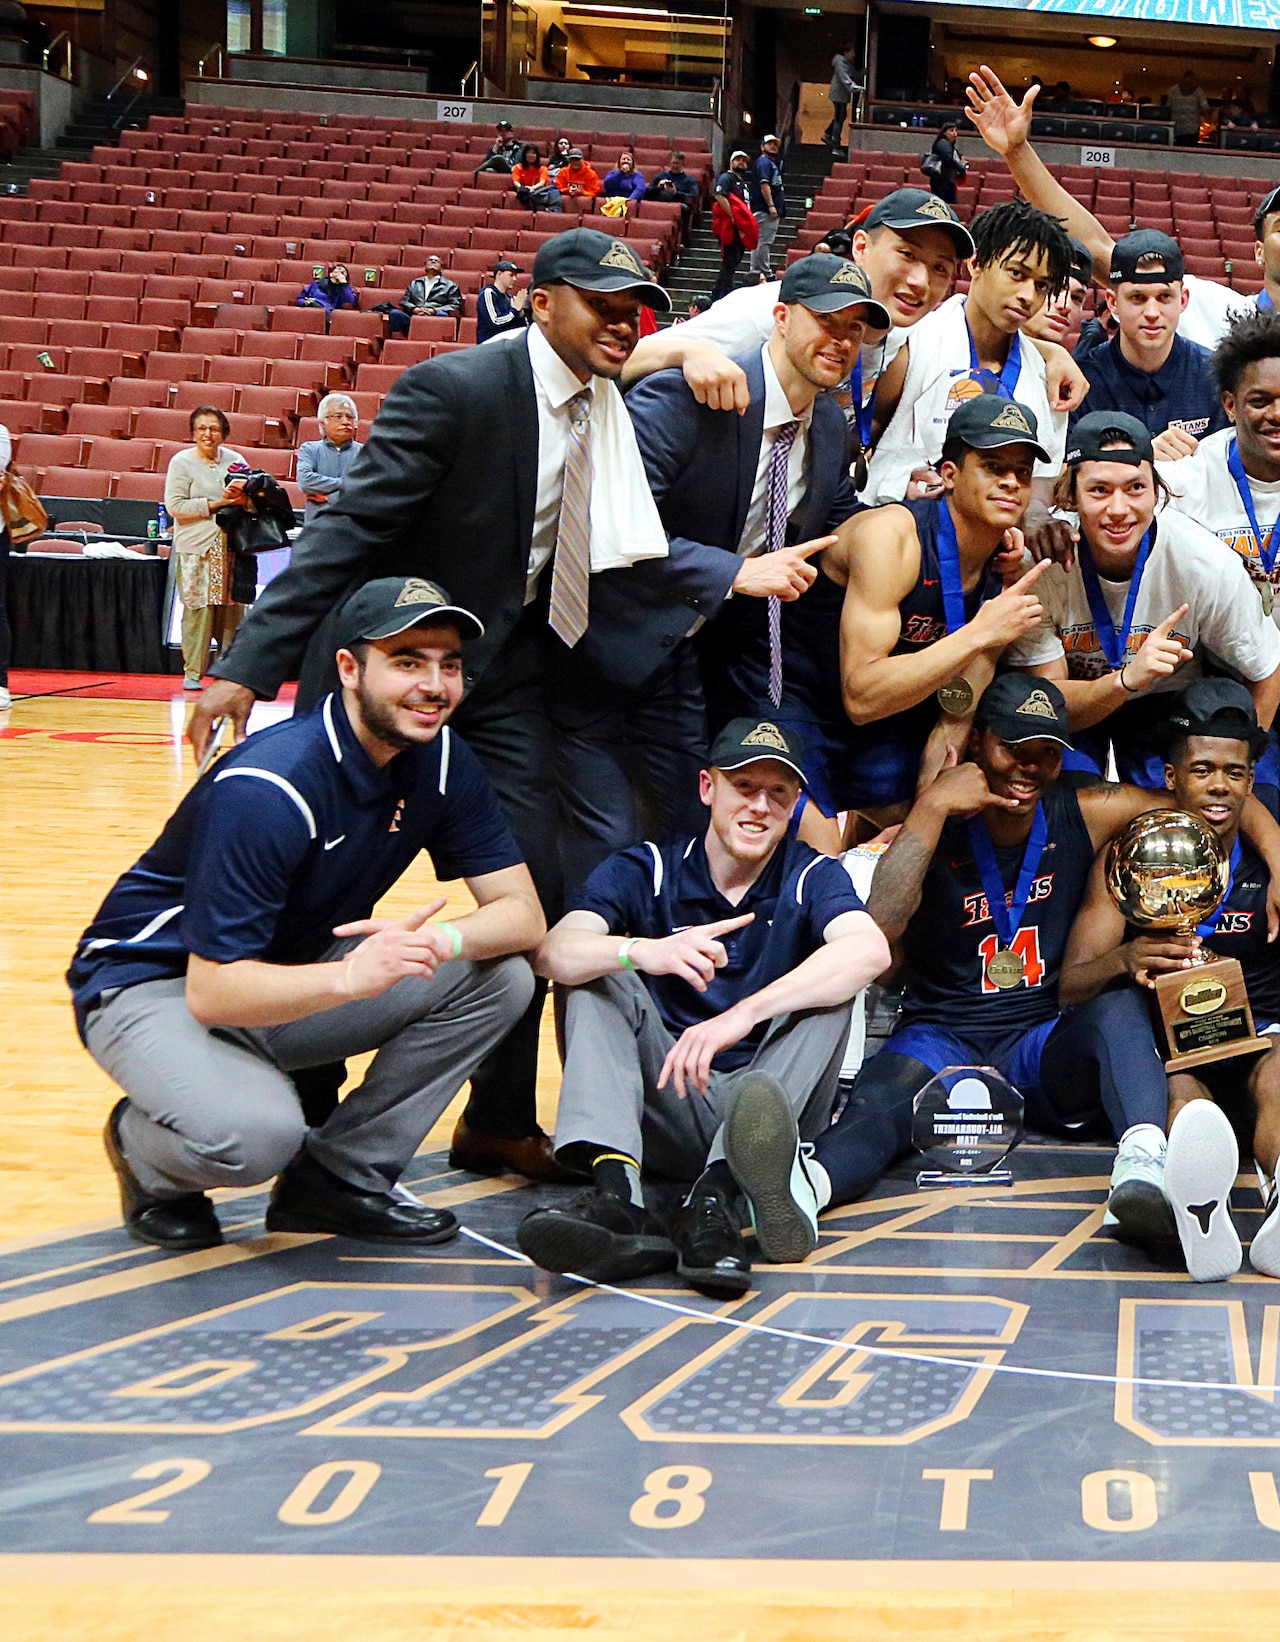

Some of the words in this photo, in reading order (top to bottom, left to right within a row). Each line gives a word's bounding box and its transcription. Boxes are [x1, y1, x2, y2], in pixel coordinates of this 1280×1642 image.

[443, 106, 467, 118] 207
[1086, 151, 1110, 163] 208
[978, 926, 1045, 994] 14
[0, 1280, 1030, 1446] BIG
[86, 1457, 713, 1530] 2018
